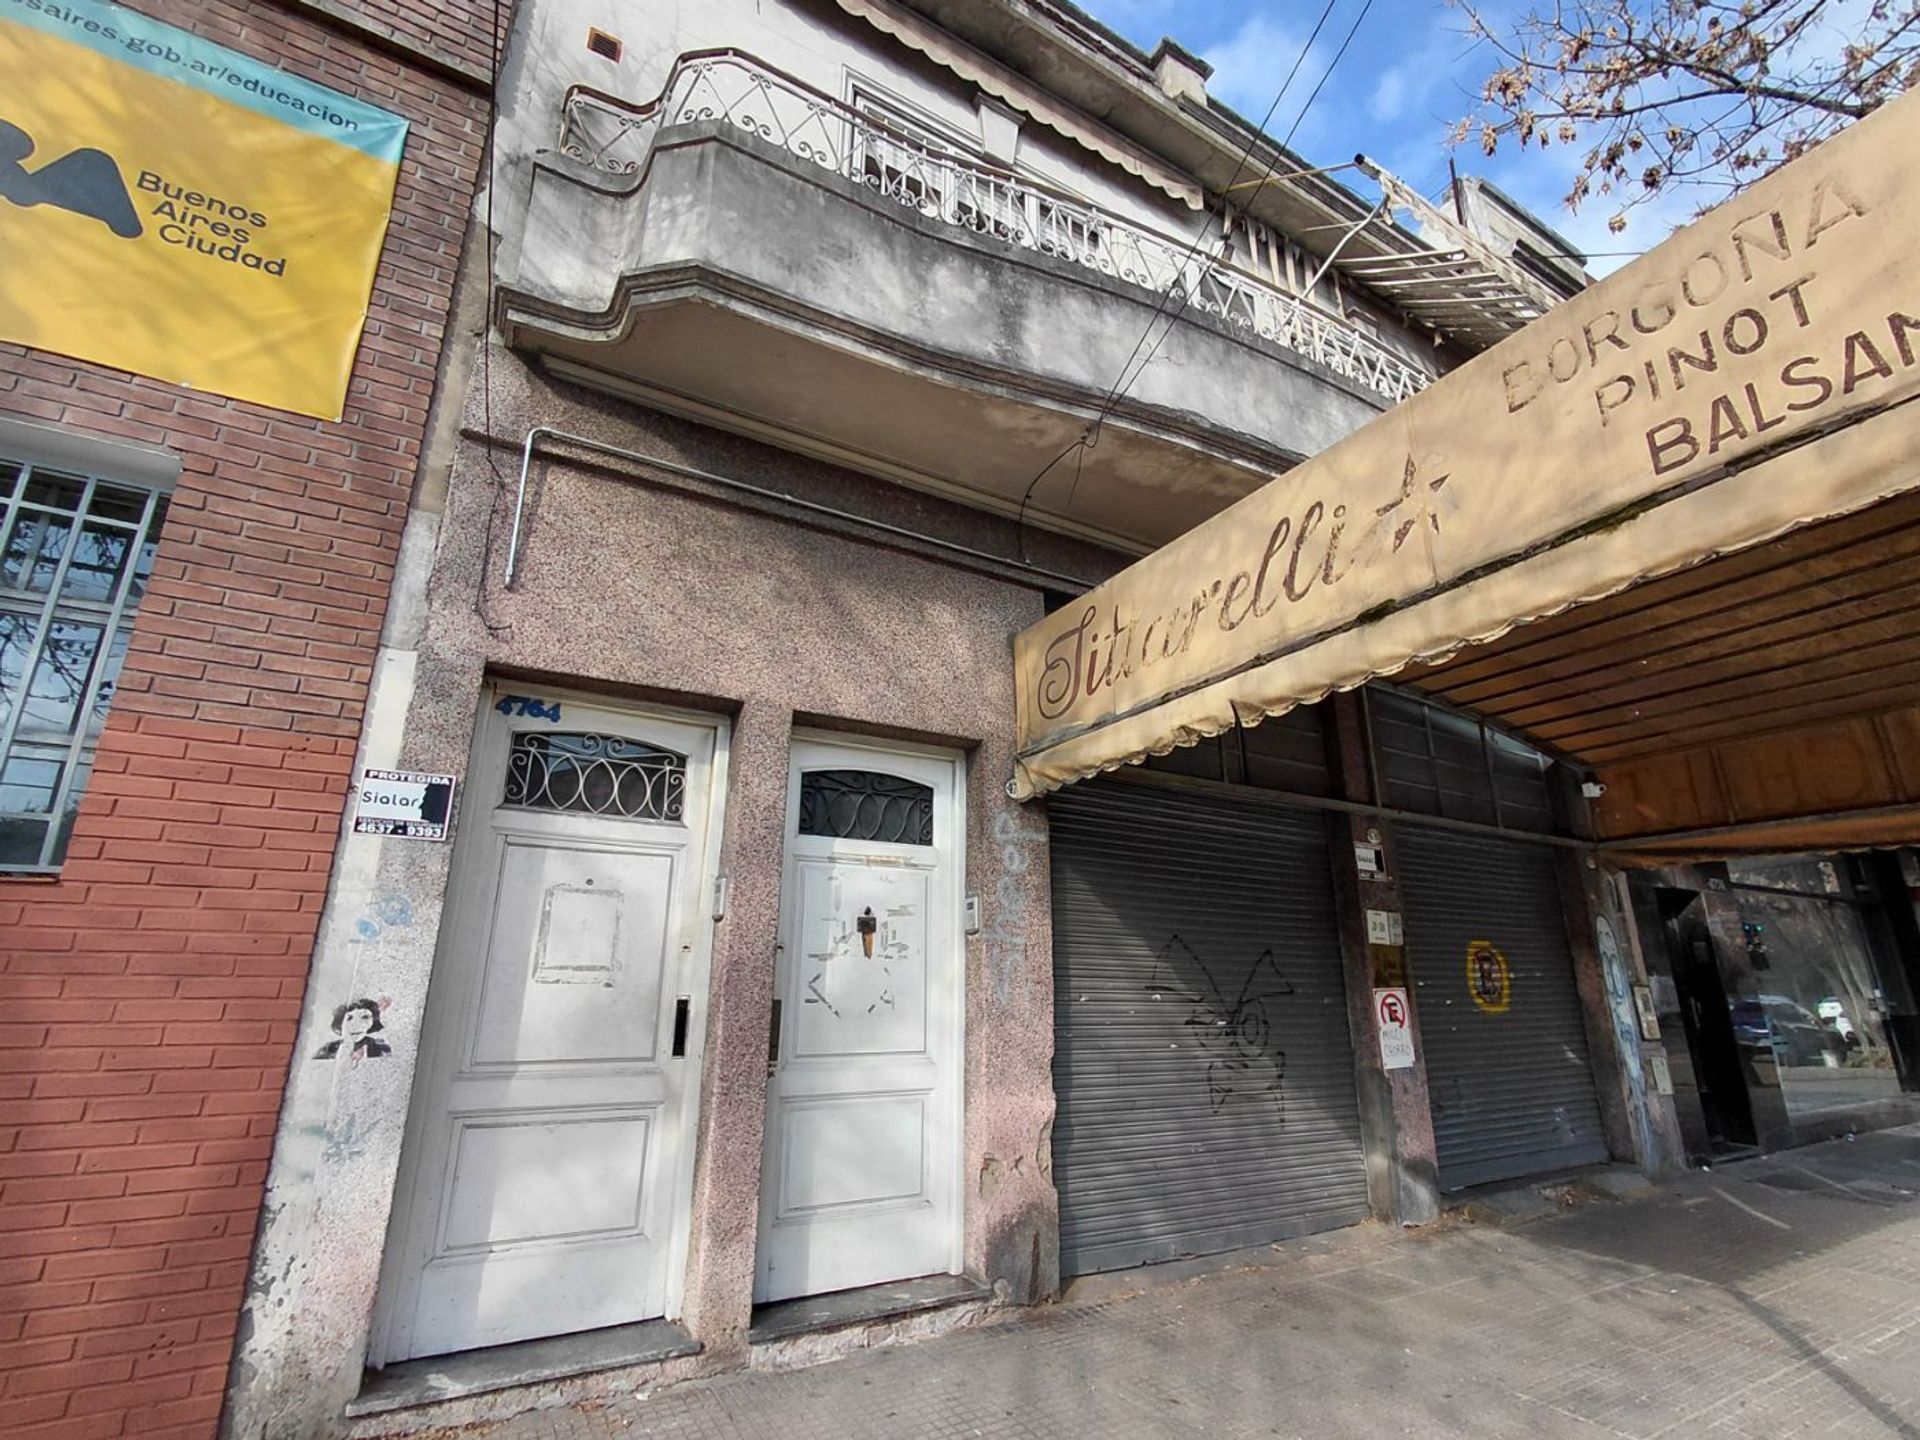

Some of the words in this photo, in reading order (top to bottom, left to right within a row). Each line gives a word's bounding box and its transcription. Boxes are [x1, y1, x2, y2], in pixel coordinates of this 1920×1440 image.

[137, 170, 267, 229] Buenos
[151, 201, 250, 244] Aires
[159, 223, 288, 279] Ciudad
[1595, 272, 1817, 427] PINOT
[495, 695, 561, 722] 4764
[369, 770, 450, 785] PROTEGIDA
[362, 791, 419, 807] Sialar
[357, 822, 394, 834] 4637
[407, 826, 442, 838] 9393
